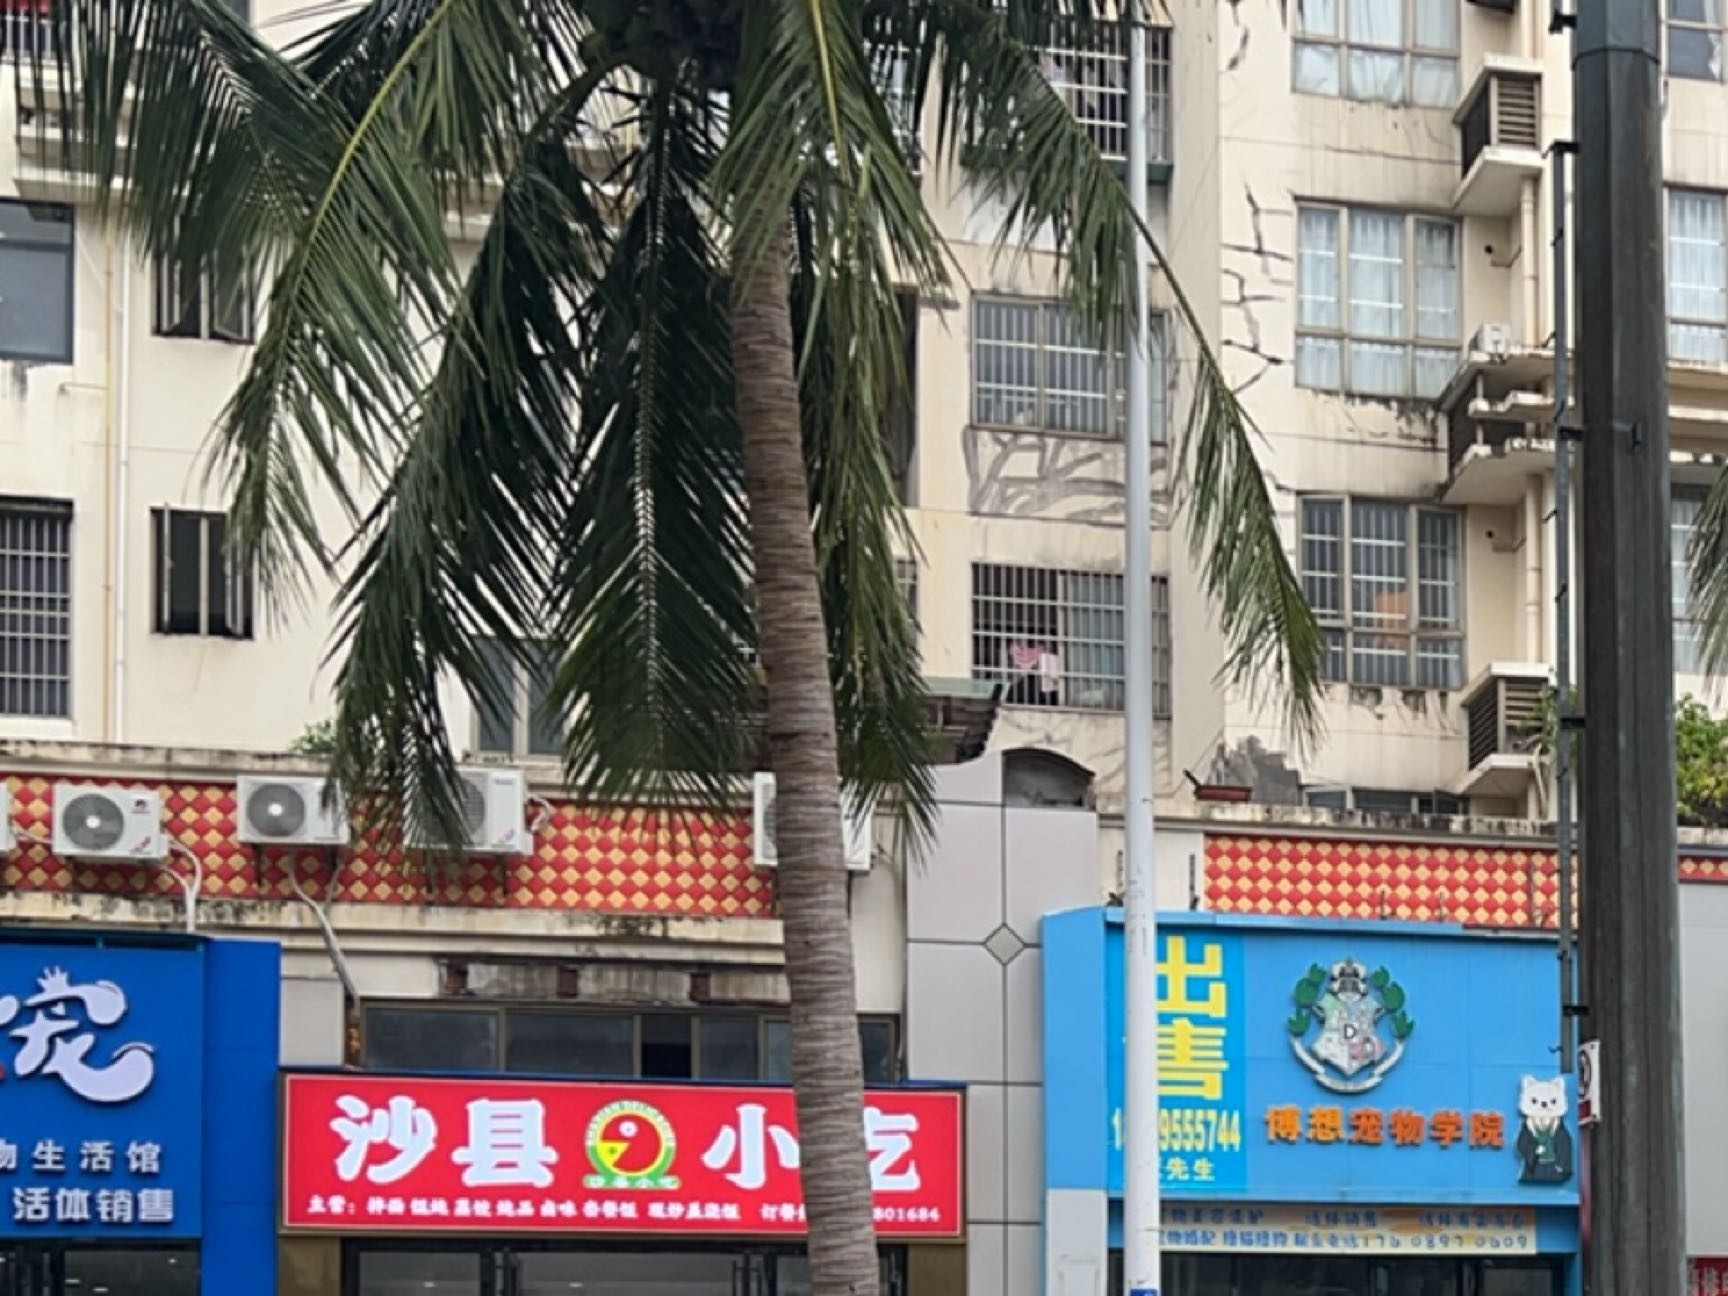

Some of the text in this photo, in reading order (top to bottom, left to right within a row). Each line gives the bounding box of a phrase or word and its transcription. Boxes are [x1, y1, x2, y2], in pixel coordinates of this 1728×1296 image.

[330, 1095, 559, 1188] 沙县
[1112, 1107, 1241, 1152] 19555744
[1159, 1158, 1215, 1182] 先生
[13, 1187, 174, 1223] 活体销售
